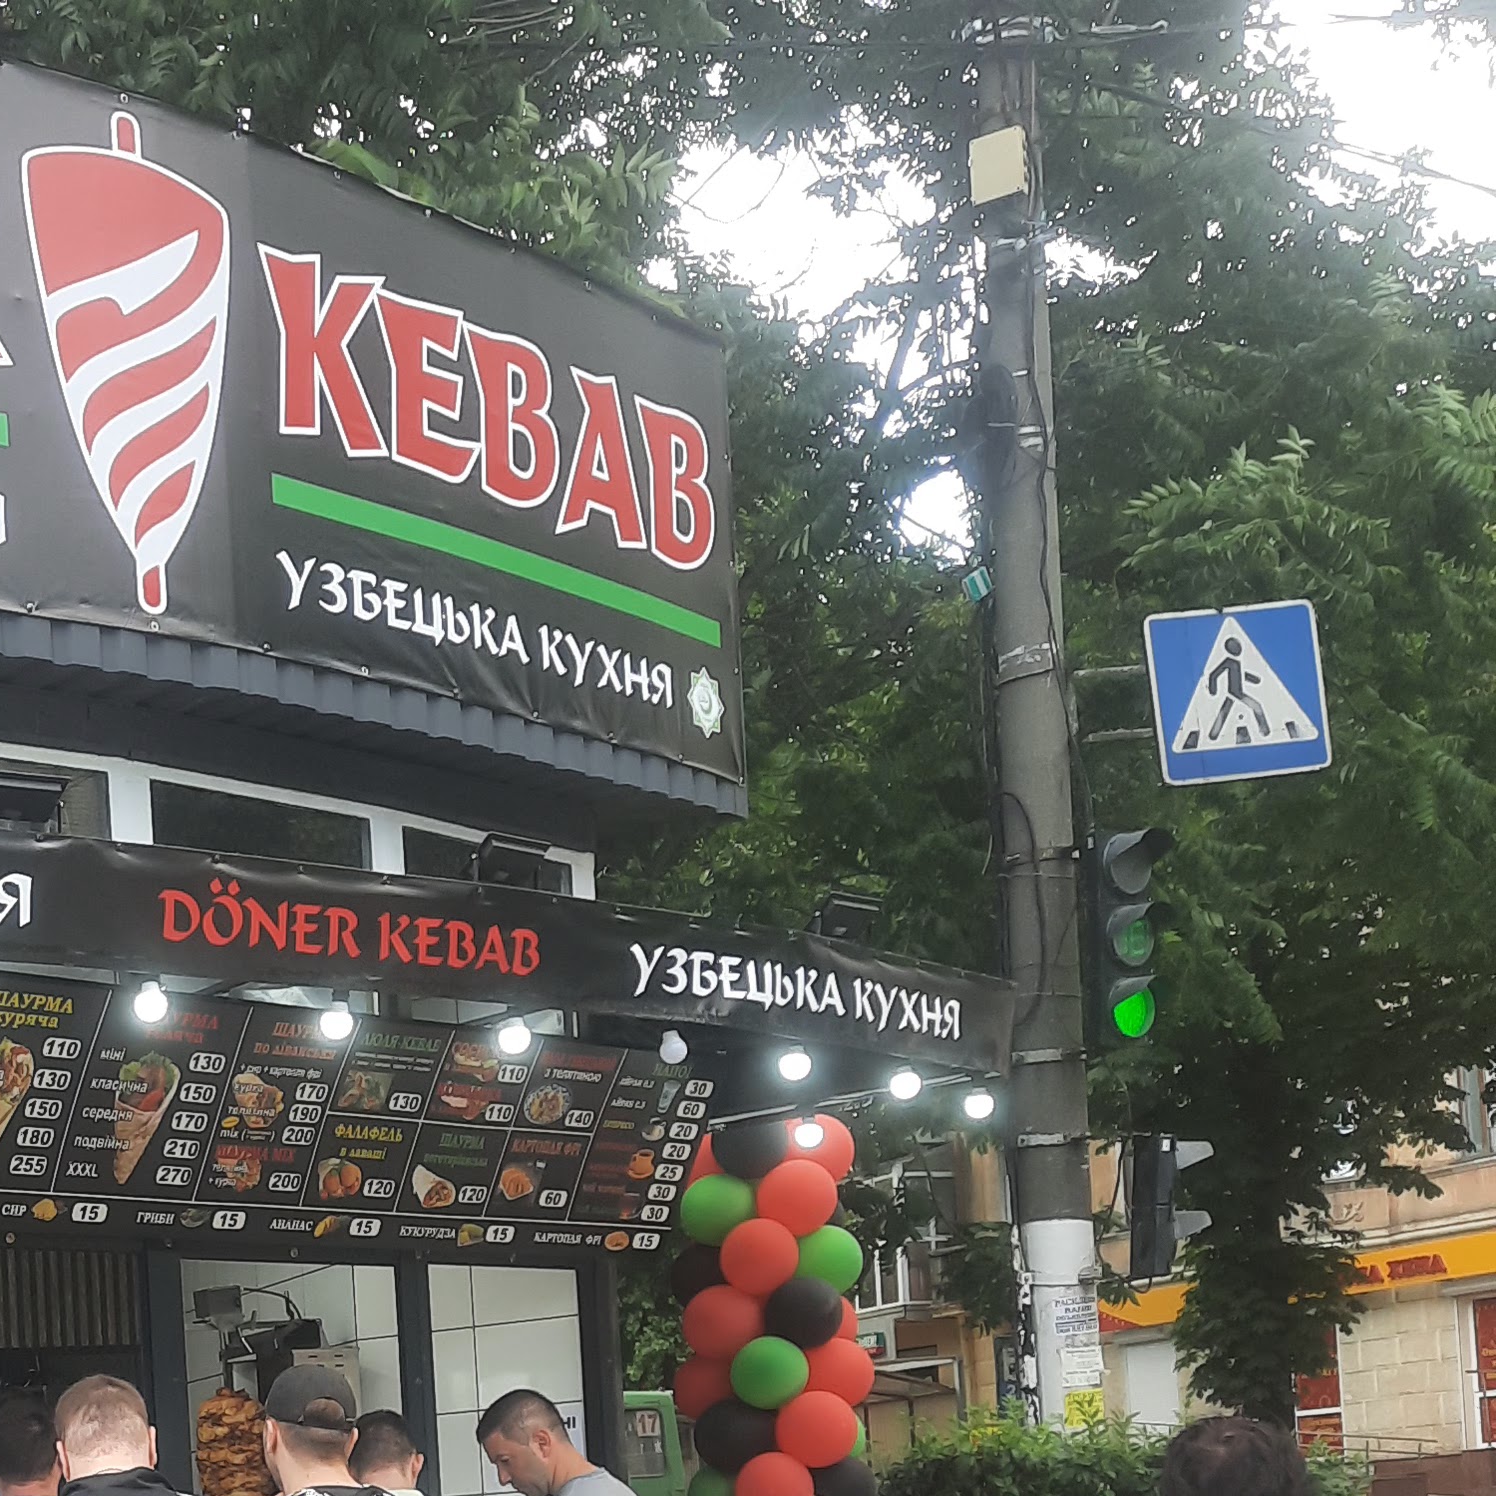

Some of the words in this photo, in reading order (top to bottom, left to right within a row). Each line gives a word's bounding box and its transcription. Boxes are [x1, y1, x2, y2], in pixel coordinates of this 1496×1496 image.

[257, 242, 716, 570] KEBAB
[275, 550, 530, 664] УЗБЕЦЬКА
[537, 624, 674, 709] КУХНЯ
[158, 877, 362, 959] DÖNER
[378, 912, 542, 977] KEBAB
[628, 941, 844, 1019] УЗБЕЦЬКА
[850, 977, 964, 1041] КУХНЯ
[44, 1039, 80, 1057] 110
[100, 1047, 127, 1062] міні
[190, 1054, 225, 1072] 130
[35, 1070, 70, 1088] 130
[501, 1067, 525, 1081] 110
[90, 1077, 149, 1094] класична
[298, 1084, 327, 1100] 170
[689, 1082, 707, 1095] 30
[182, 1087, 214, 1102] 150
[392, 1095, 420, 1110] 130
[27, 1100, 61, 1118] 150
[82, 1106, 135, 1123] середня
[292, 1105, 319, 1121] 190
[488, 1106, 512, 1120] 110
[682, 1103, 700, 1116] 60
[174, 1114, 206, 1130] 170
[567, 1112, 591, 1126] 140
[19, 1129, 52, 1147] 180
[284, 1127, 313, 1143] 200
[334, 1123, 403, 1144] ФАЛАФЕЛЬ
[673, 1125, 693, 1138] 20
[74, 1134, 131, 1151] подвійна
[165, 1142, 198, 1158] 210
[667, 1145, 686, 1158] 20
[11, 1157, 46, 1174] 255
[66, 1162, 99, 1178] XXXL
[659, 1166, 678, 1179] 25
[158, 1168, 192, 1184] 270
[271, 1175, 300, 1190] 200
[366, 1181, 394, 1196] 120
[461, 1188, 484, 1201] 120
[653, 1186, 671, 1199] 30
[545, 1192, 561, 1205] 60
[78, 1205, 100, 1221] 15
[219, 1213, 239, 1227] 15
[646, 1207, 664, 1220] 30
[355, 1220, 374, 1234] 15
[492, 1227, 509, 1240] 15
[638, 1234, 655, 1247] 15
[638, 1413, 658, 1434] 17
